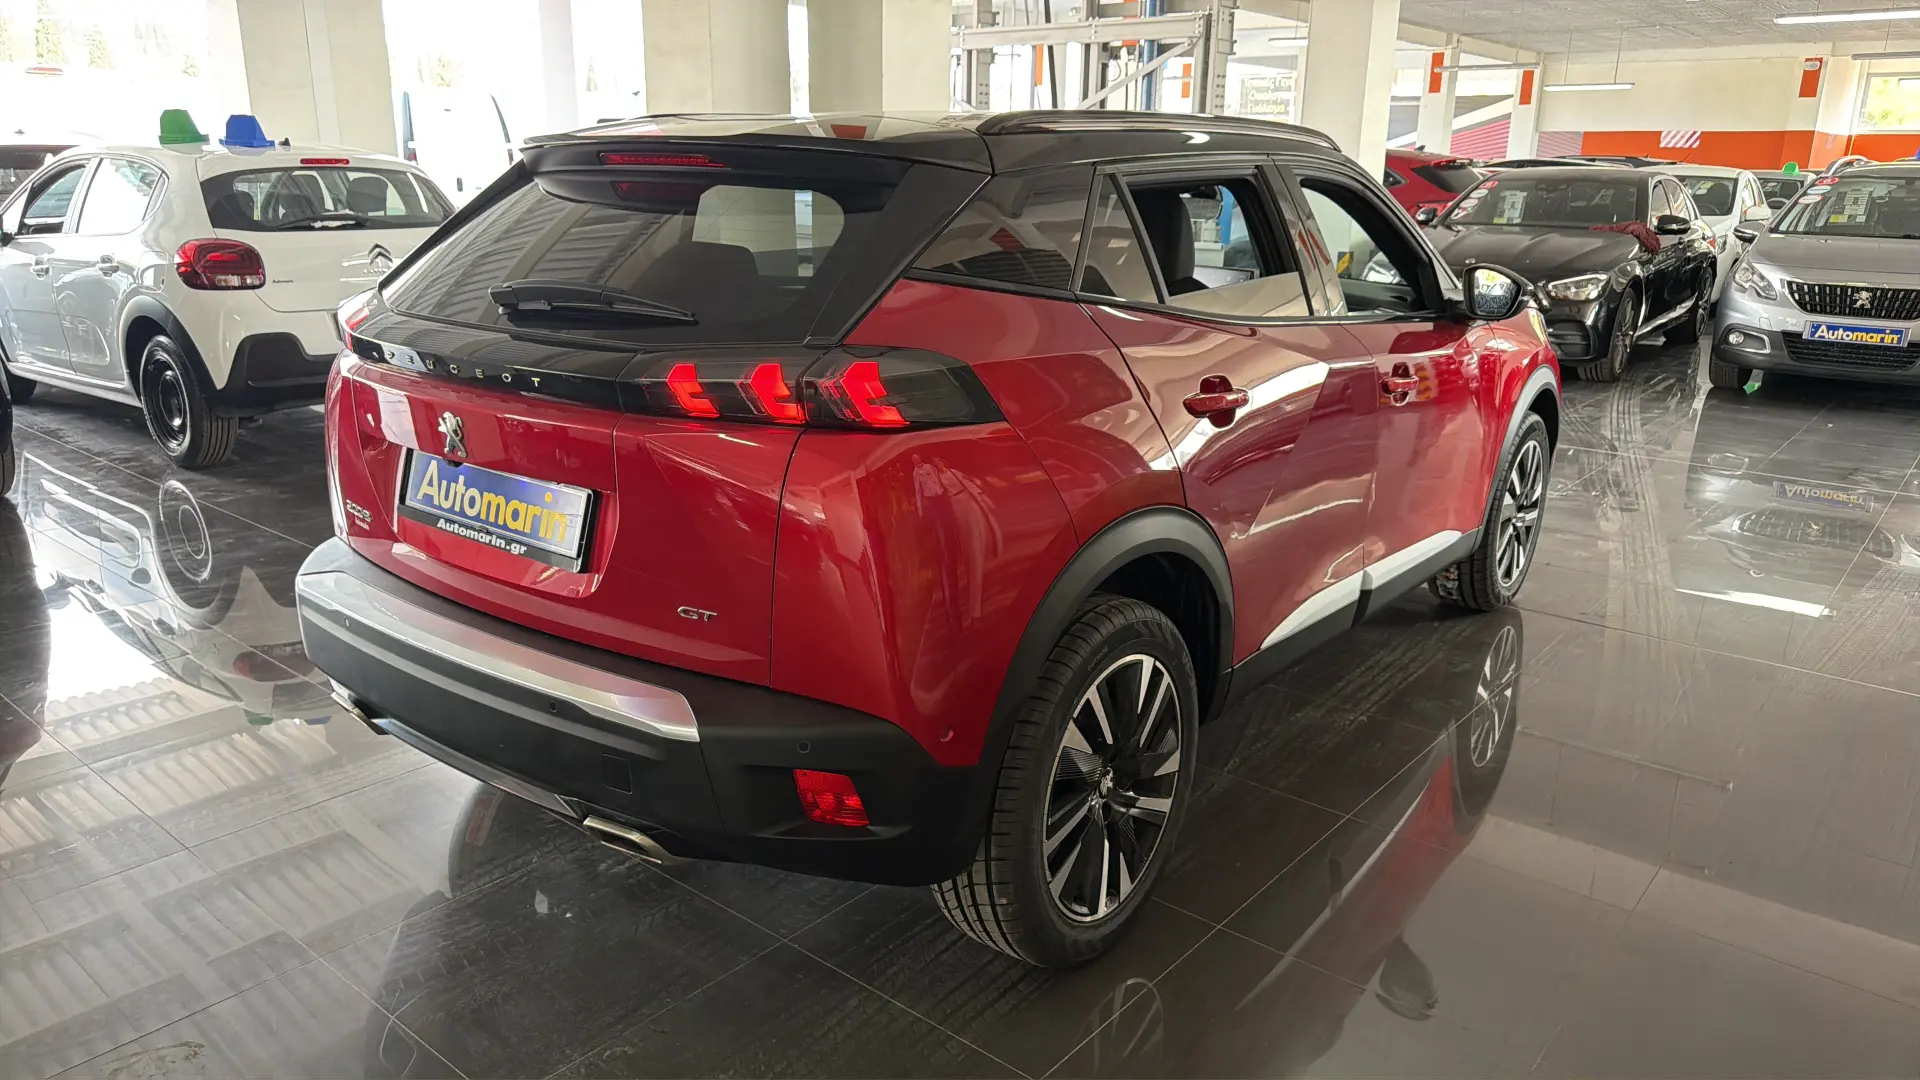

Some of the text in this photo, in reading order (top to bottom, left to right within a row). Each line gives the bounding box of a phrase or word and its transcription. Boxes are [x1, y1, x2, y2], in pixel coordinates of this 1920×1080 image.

[1814, 324, 1899, 344] Automarin
[386, 350, 541, 388] PEUGEOT
[416, 459, 568, 544] Automarin
[436, 518, 528, 555] Automarin.gr
[677, 606, 718, 622] GT
